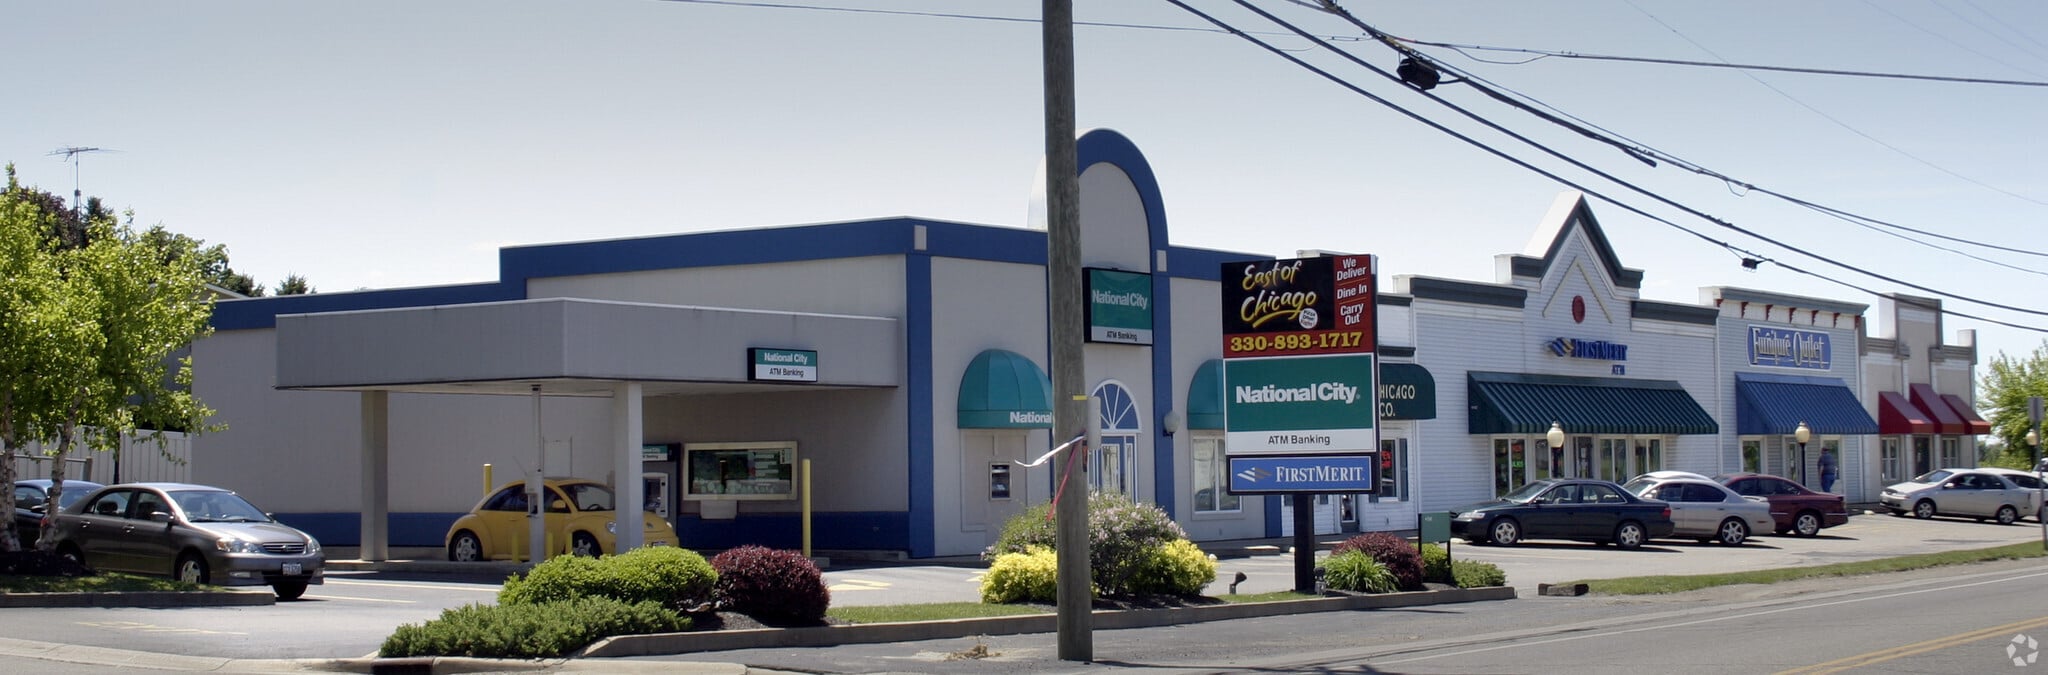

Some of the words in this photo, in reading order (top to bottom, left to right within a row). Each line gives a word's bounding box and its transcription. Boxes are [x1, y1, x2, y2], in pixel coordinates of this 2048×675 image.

[1343, 258, 1356, 268] We
[1242, 262, 1280, 290] East
[1281, 260, 1302, 283] of
[1337, 266, 1367, 281] Deliver
[1337, 287, 1356, 299] Dine
[1359, 284, 1367, 294] In
[1092, 289, 1129, 306] National
[1130, 292, 1148, 310] City
[1241, 289, 1317, 322] Chicago
[1340, 303, 1363, 317] Carry
[1345, 315, 1360, 326] Out
[1106, 331, 1117, 339] ATM
[1118, 331, 1137, 341] Banking
[1231, 331, 1363, 352] 330-893-1717
[1752, 328, 1791, 364] Furniture
[1793, 331, 1824, 368] Outlet
[764, 352, 793, 363] National
[794, 353, 808, 365] City
[783, 368, 804, 377] Banking
[1236, 383, 1316, 404] National
[1317, 382, 1358, 404] City
[1379, 384, 1415, 399] HICAGO
[1379, 402, 1395, 416] CO.
[1010, 411, 1052, 424] National
[1268, 435, 1288, 445] ATM
[1291, 434, 1331, 446] Banking
